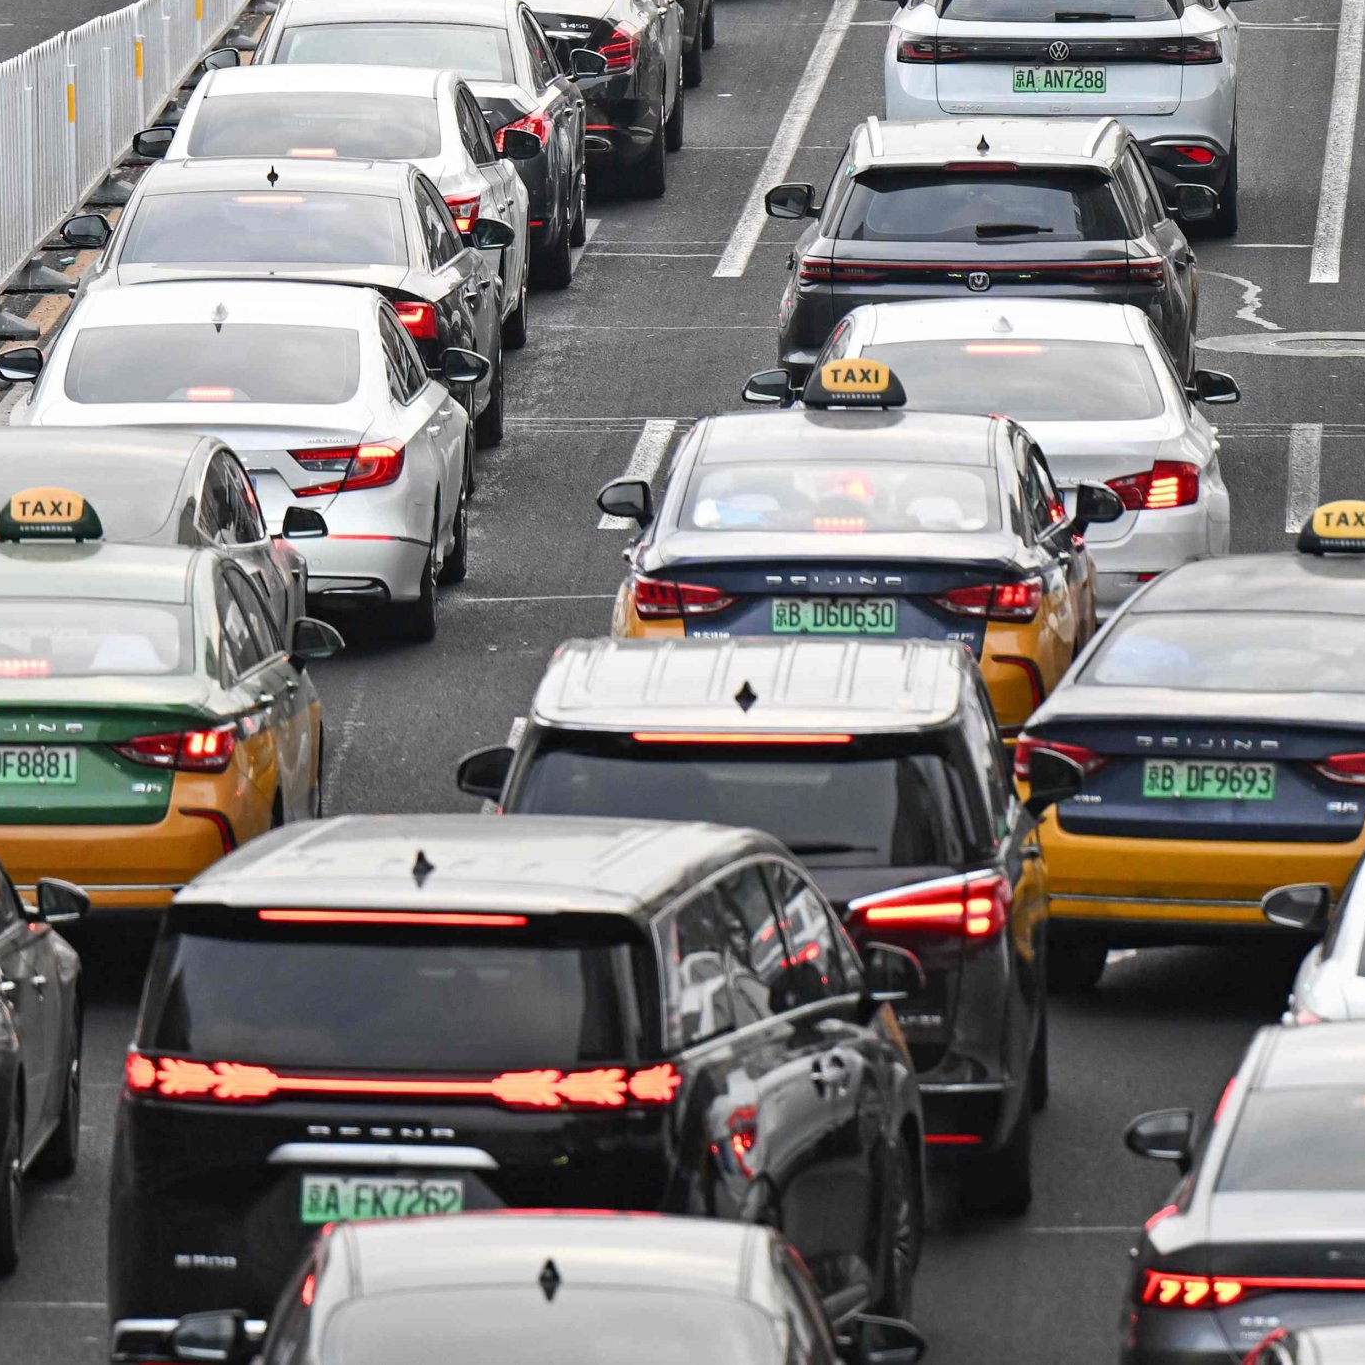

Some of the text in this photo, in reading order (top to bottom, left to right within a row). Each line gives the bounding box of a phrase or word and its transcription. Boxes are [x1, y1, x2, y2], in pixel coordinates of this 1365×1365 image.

[1043, 71, 1104, 91] AN7288
[830, 370, 879, 383] TAXI
[20, 501, 72, 516] TAXI
[813, 602, 893, 629] D60630
[1186, 765, 1273, 796] DF9693
[353, 1181, 456, 1217] FK7262
